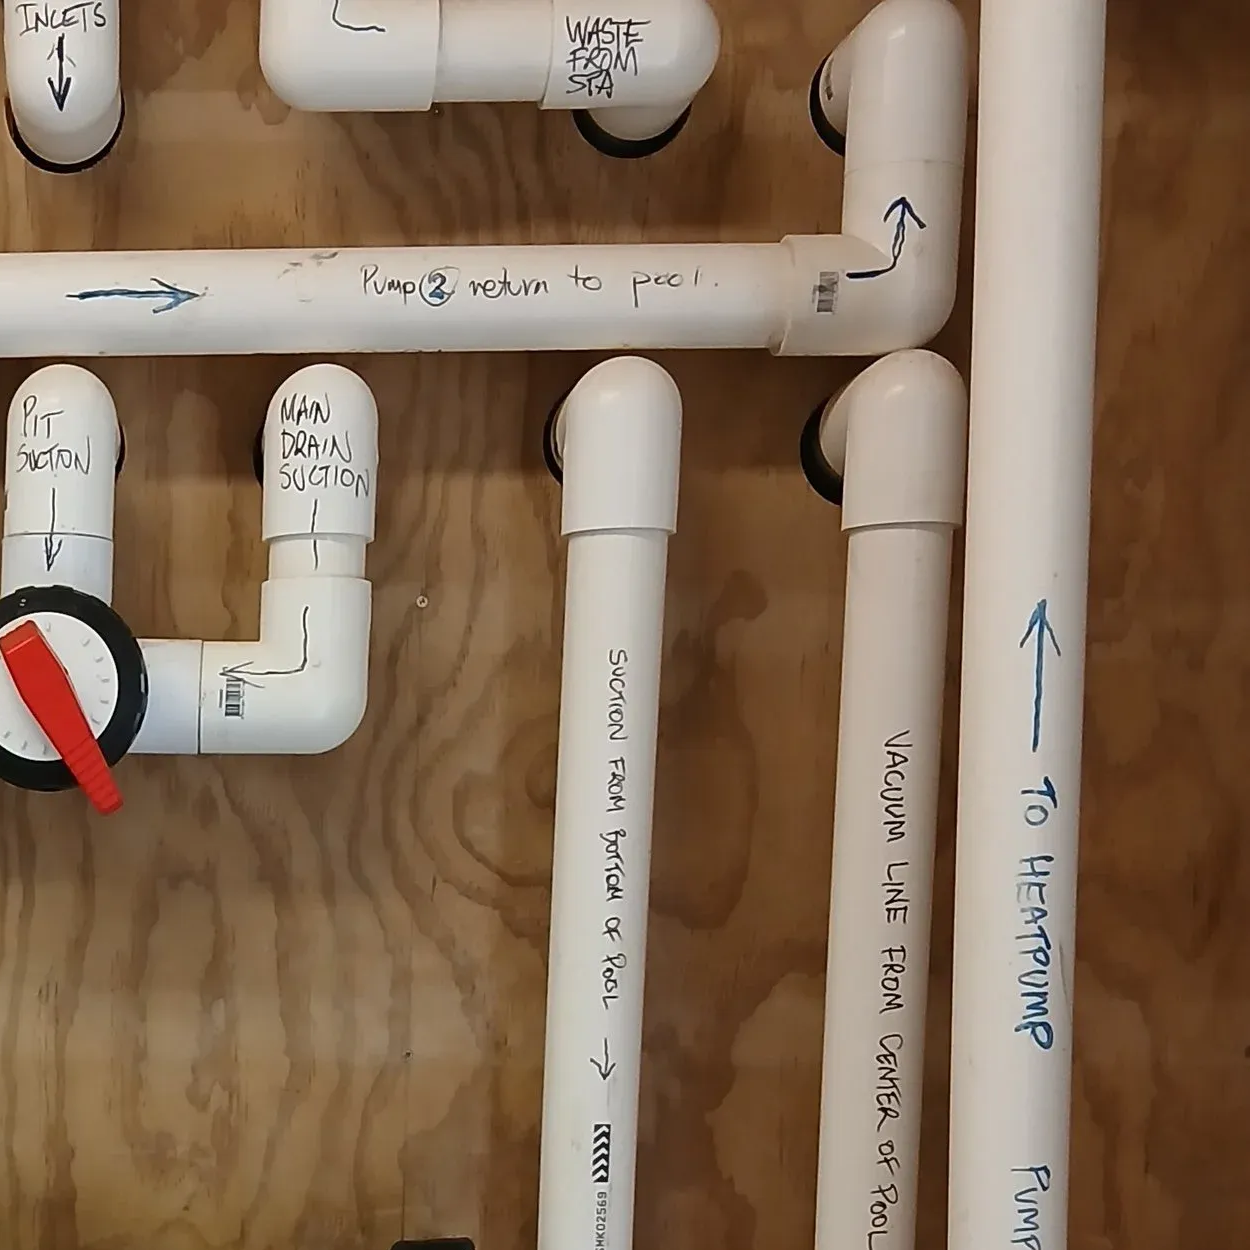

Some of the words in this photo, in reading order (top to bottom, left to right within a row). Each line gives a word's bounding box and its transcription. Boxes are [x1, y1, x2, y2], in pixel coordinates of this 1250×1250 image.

[565, 16, 651, 50] WASTE
[565, 46, 638, 76] FROM
[360, 263, 416, 305] Pump
[469, 266, 549, 299] return
[567, 264, 603, 291] to
[21, 395, 65, 439] PIT
[280, 392, 331, 426] MAIN
[15, 435, 92, 475] SUCTION
[280, 429, 352, 464] DRAIN
[279, 463, 371, 498] SUCTION
[607, 648, 629, 742] SUCTION
[605, 756, 626, 813] FROM
[879, 729, 913, 842] VACUUM
[1020, 776, 1059, 827] TO
[599, 828, 627, 902] BOTTOM
[881, 861, 911, 924] LINE
[602, 916, 623, 942] OF
[1013, 854, 1055, 1050] HEATPUMP
[879, 944, 907, 1015] FROM
[875, 1033, 904, 1133] CENTER
[876, 1139, 901, 1177] OF
